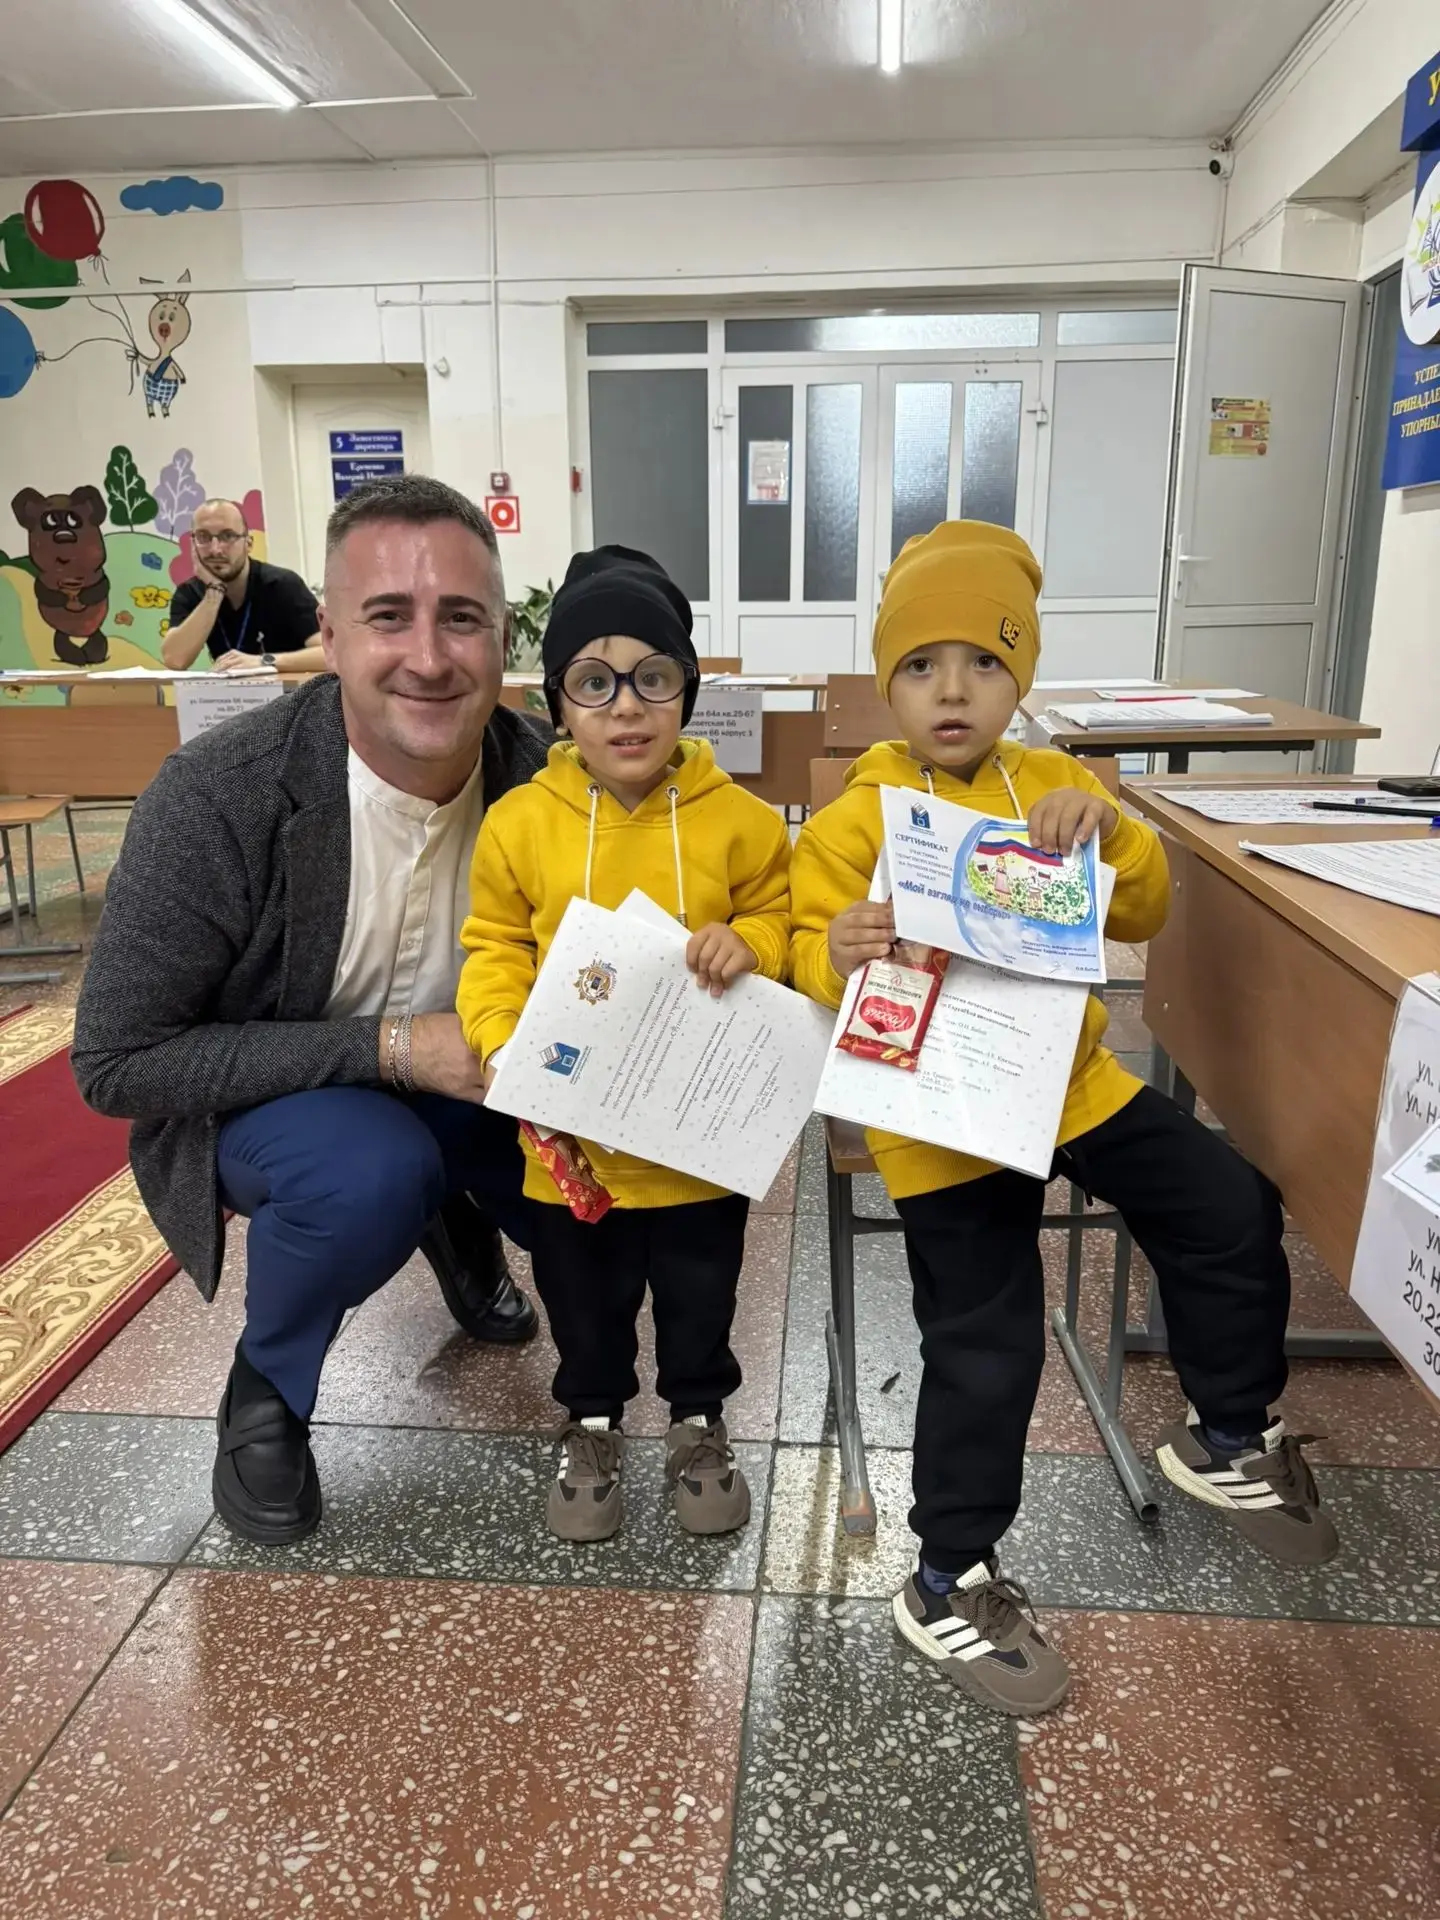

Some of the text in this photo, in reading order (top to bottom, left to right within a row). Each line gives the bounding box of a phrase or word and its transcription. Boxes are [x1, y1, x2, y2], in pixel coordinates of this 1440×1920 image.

[335, 436, 343, 448] 5
[894, 832, 949, 853] СЕРТИФИКАТ
[896, 877, 926, 895] «Мой
[1416, 1059, 1434, 1088] ул.
[1405, 1090, 1422, 1119] ул.
[1408, 1249, 1426, 1280] ул.
